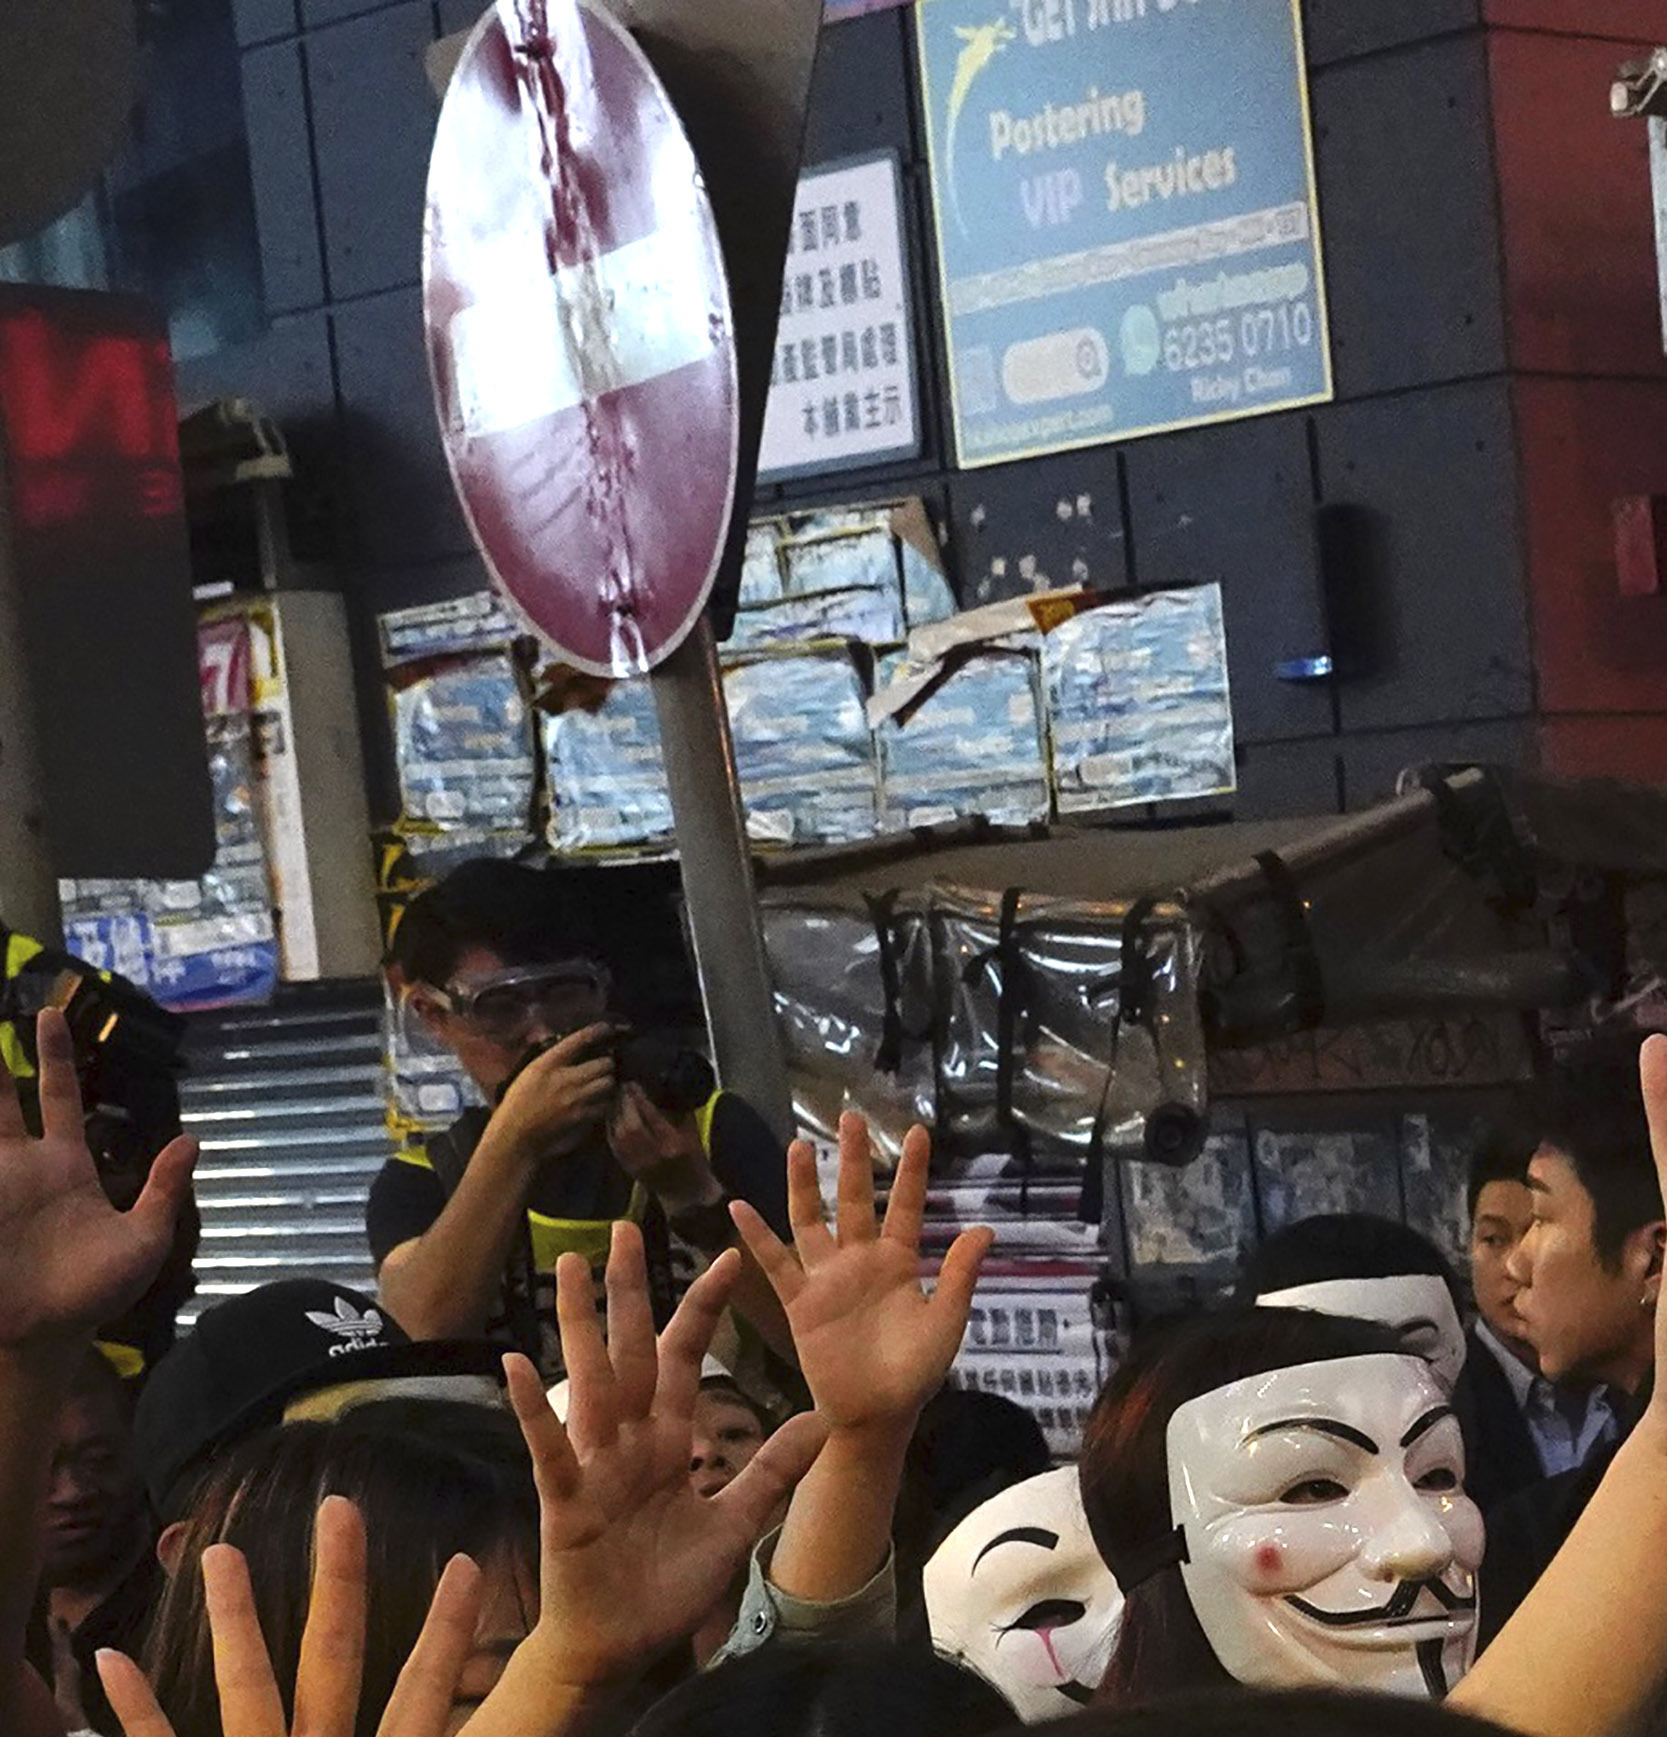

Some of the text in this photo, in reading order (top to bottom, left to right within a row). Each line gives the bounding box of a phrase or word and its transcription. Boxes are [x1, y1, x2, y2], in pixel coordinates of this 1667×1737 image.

[989, 86, 1147, 160] Postering
[1021, 146, 1237, 228] VIP Services
[1163, 302, 1312, 371] 6235 0710
